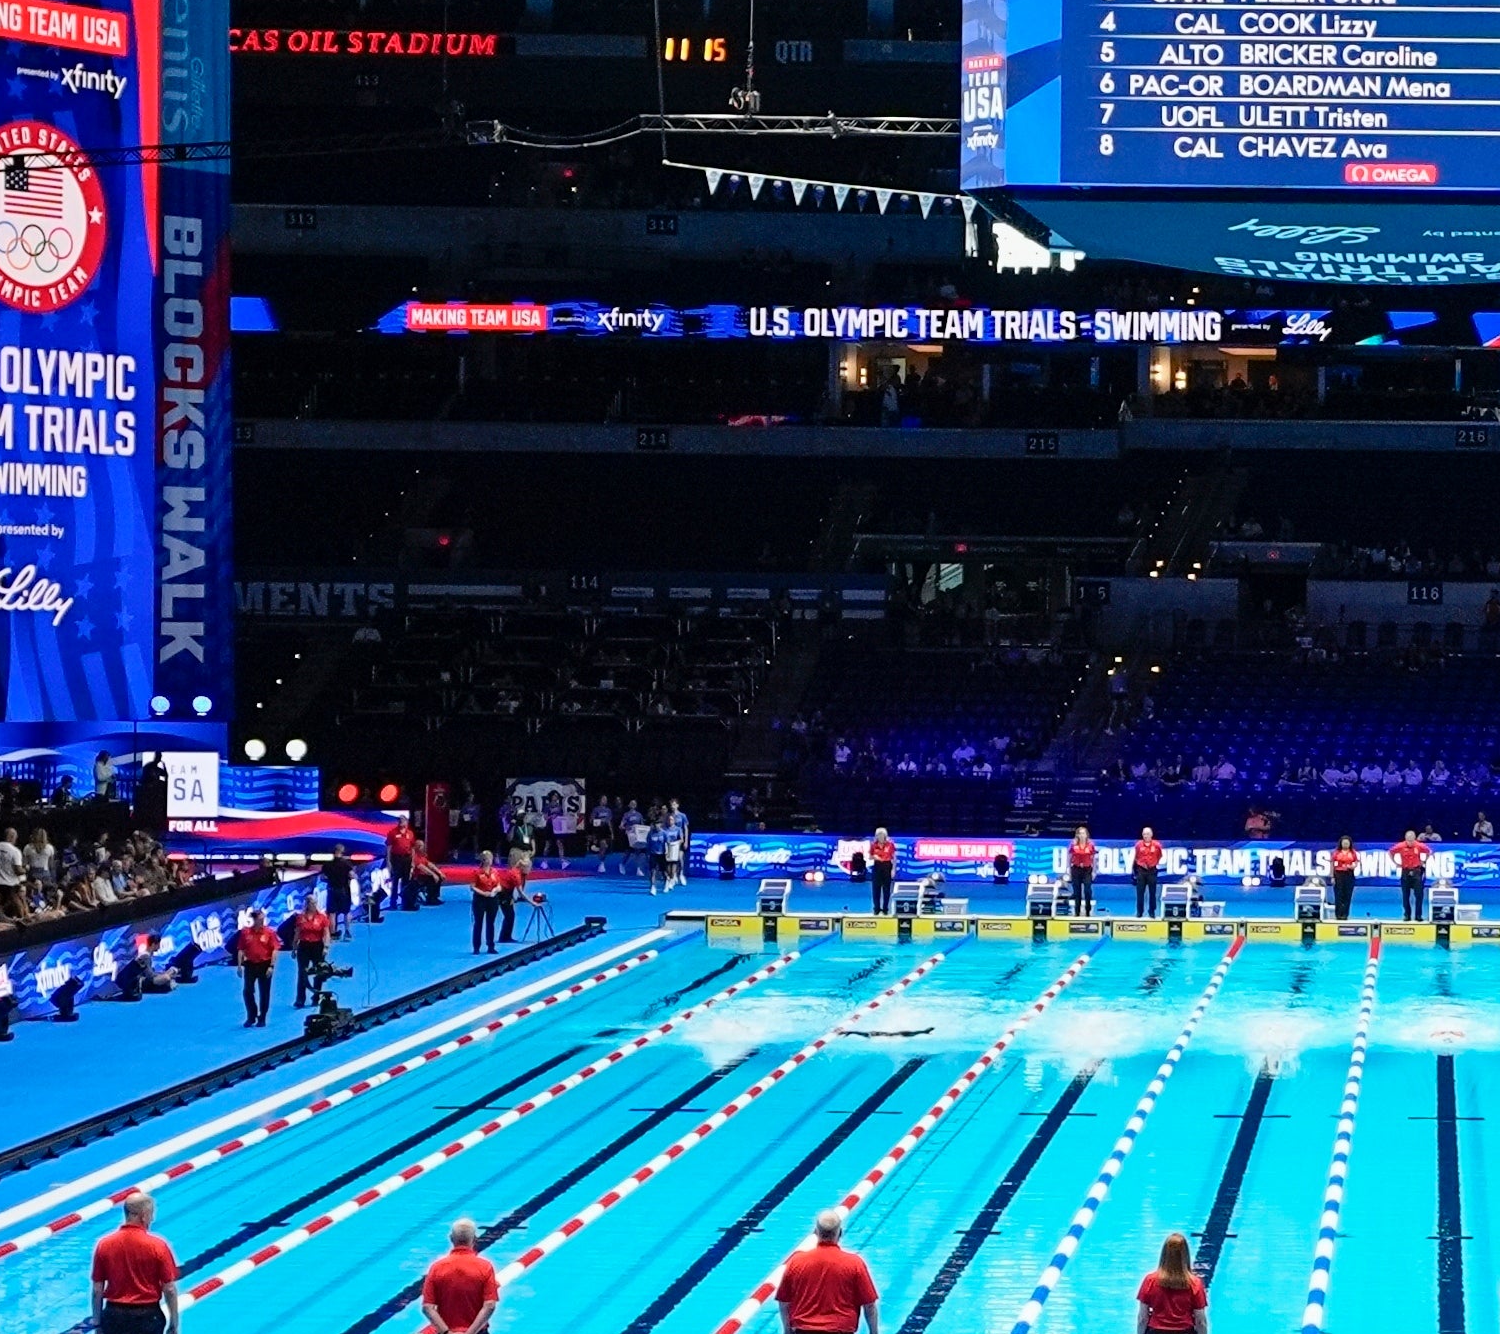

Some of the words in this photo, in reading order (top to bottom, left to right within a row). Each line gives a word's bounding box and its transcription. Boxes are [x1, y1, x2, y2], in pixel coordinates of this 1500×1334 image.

[26, 4, 78, 43] TEAM
[82, 11, 122, 49] USA
[1099, 12, 1117, 33] 4
[1174, 13, 1226, 35] CAL
[1238, 13, 1318, 35] COOK
[1320, 13, 1378, 39] Lizzy
[1099, 42, 1116, 64] 5
[1158, 44, 1225, 66] ALTO
[1238, 43, 1338, 66] BRICKER
[1341, 44, 1439, 68] Caroline
[61, 62, 128, 101] xfinity
[1099, 73, 1116, 95] 6
[1128, 74, 1224, 97] PAC-OR
[1238, 74, 1382, 98] BOARDMAN
[1384, 76, 1452, 99] Mena
[963, 86, 1004, 124] USA
[1099, 103, 1116, 124] 7
[1160, 105, 1224, 128] UOFL
[1238, 105, 1311, 129] ULETT
[1313, 105, 1388, 129] Tristen
[1099, 133, 1115, 156] 8
[1172, 136, 1224, 159] CAL
[1237, 136, 1338, 160] CHAVEZ
[1340, 137, 1388, 160] Ava
[48, 267, 89, 306] TEAM
[410, 307, 467, 328] MAKING
[469, 308, 507, 328] TEAM
[510, 309, 542, 328] USA
[597, 306, 666, 334] xfinity
[749, 307, 796, 338] U.S.
[803, 307, 909, 339] OLYMPIC
[915, 307, 984, 340] TEAM
[162, 214, 206, 470] BLOCKS
[23, 404, 136, 457] TRIALS
[159, 485, 206, 664] WALK
[168, 820, 194, 832] FOR
[194, 820, 218, 832] ALL
[732, 845, 792, 868] Sports
[919, 843, 957, 859] MAKING
[957, 844, 986, 859] TEAM
[989, 844, 1012, 859] USA
[1193, 848, 1252, 876] TEAM
